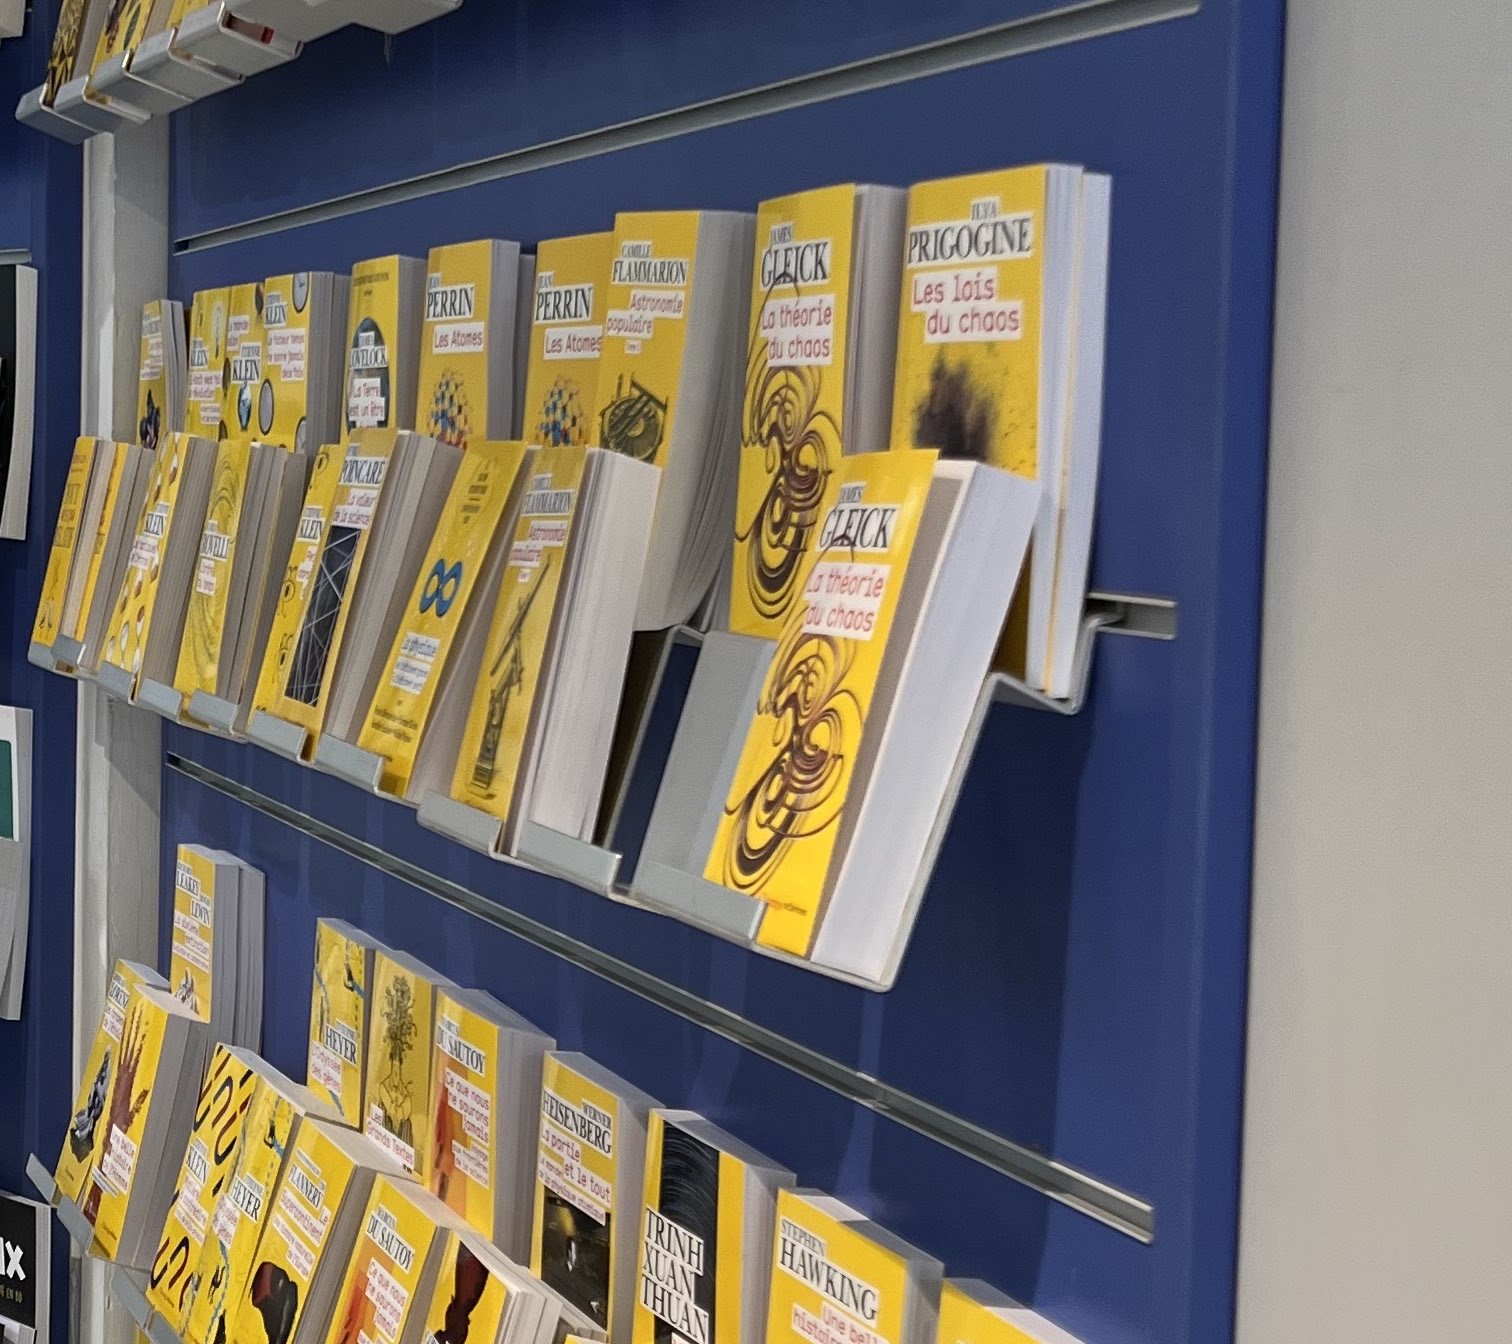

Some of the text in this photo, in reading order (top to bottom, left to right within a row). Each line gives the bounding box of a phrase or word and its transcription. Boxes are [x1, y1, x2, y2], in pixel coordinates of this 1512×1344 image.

[908, 217, 1032, 264] PRIGOGINE
[612, 261, 688, 284] FLAMMARION
[761, 242, 829, 287] GLEICK
[426, 286, 474, 320] PERRIN
[535, 286, 593, 321] PERRIN
[630, 291, 683, 314] Astronomie
[913, 272, 995, 306] Les lois
[607, 315, 653, 334] populaire
[762, 299, 831, 331] La théorie
[927, 308, 1020, 336] du chaos
[433, 329, 483, 350] Les Atomes
[545, 333, 602, 354] Les Atomes
[769, 335, 830, 361] du chaos
[232, 358, 260, 382] KLEIN
[819, 507, 896, 548] GLEICK
[826, 566, 884, 598] théorie
[826, 601, 875, 633] chaos
[325, 1025, 357, 1065] HEYER
[447, 1035, 485, 1074] SAUTOY
[543, 1093, 612, 1155] HEISENBERG
[232, 1176, 261, 1222] HEYER
[290, 1169, 324, 1208] FLANNERY
[564, 1160, 611, 1203] et le tout
[366, 1213, 415, 1270] DU SAUTOY
[646, 1212, 703, 1273] TRINH
[781, 1218, 826, 1257] STEPHEN
[642, 1245, 696, 1302] XUAN
[780, 1239, 878, 1322] HAWKING
[642, 1274, 710, 1344] THUAN
[823, 1304, 846, 1336] Une
